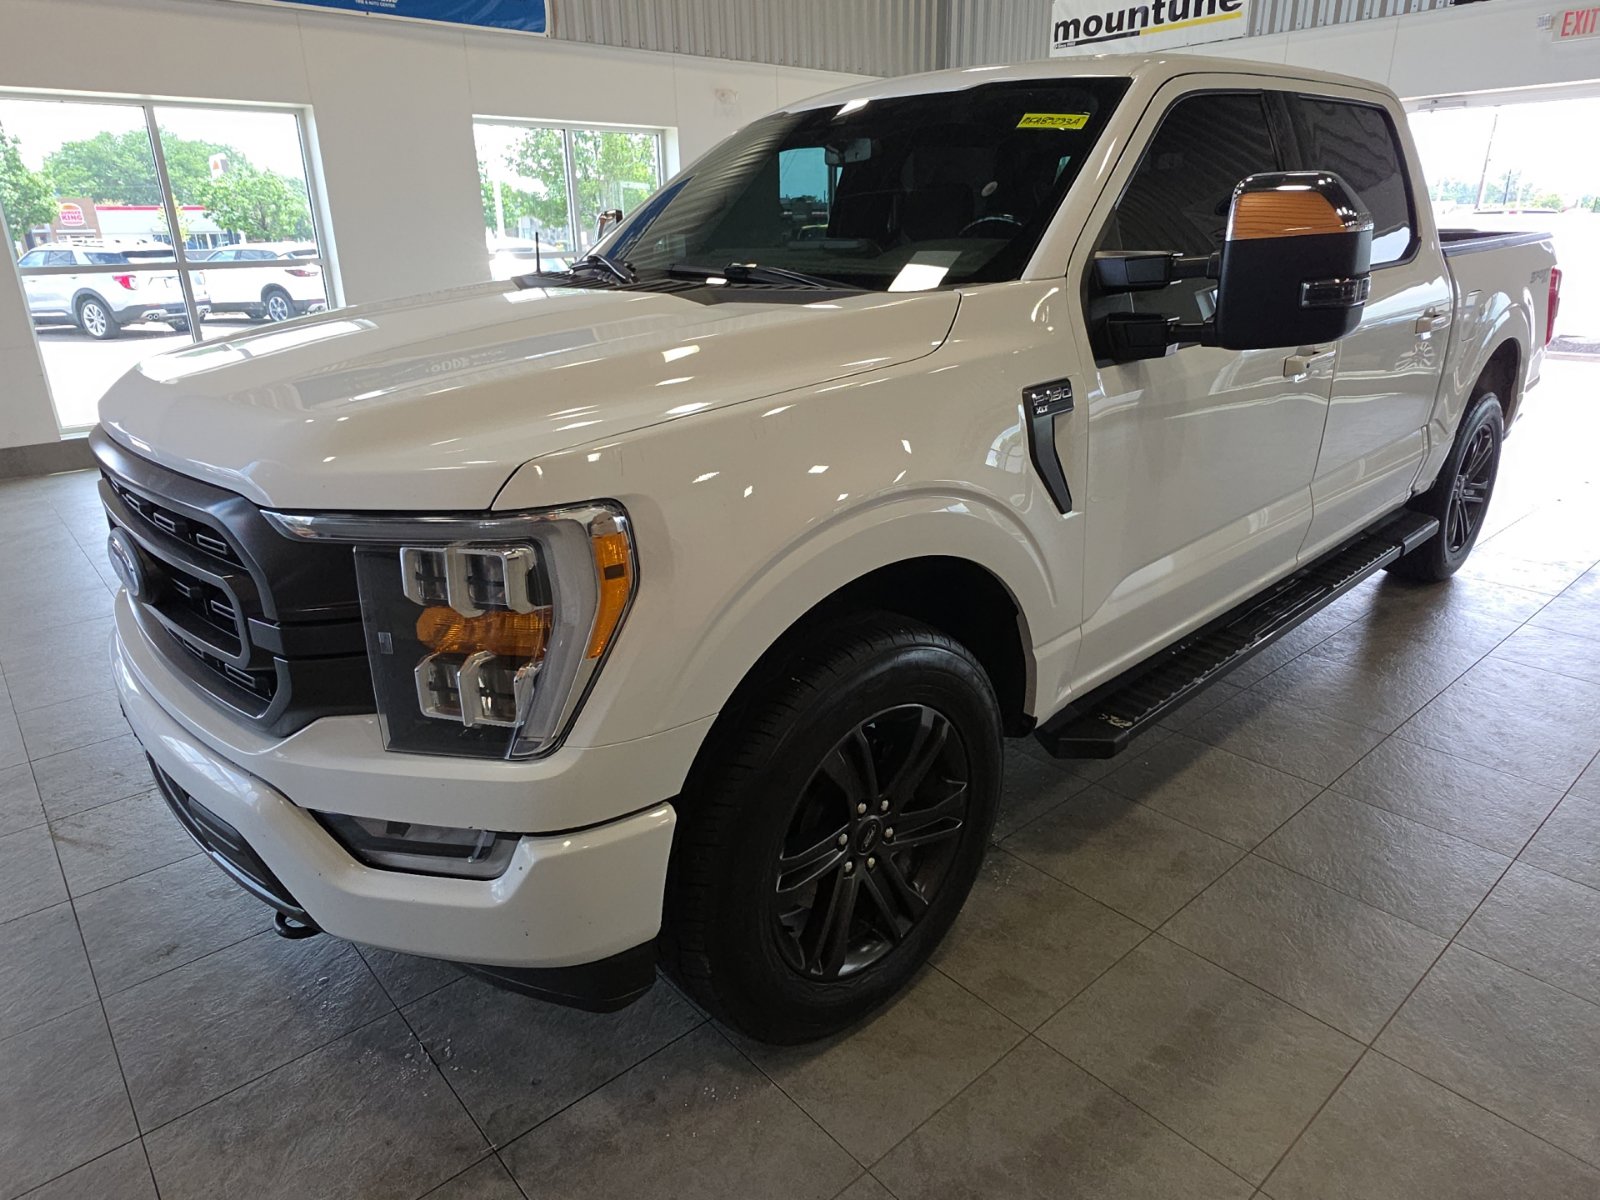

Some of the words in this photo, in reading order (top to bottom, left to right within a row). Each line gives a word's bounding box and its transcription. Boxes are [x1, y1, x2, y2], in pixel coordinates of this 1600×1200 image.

[1054, 0, 1242, 42] mountune
[1560, 8, 1600, 36] EXIT
[1032, 388, 1072, 406] F-150
[1036, 405, 1048, 414] XLT
